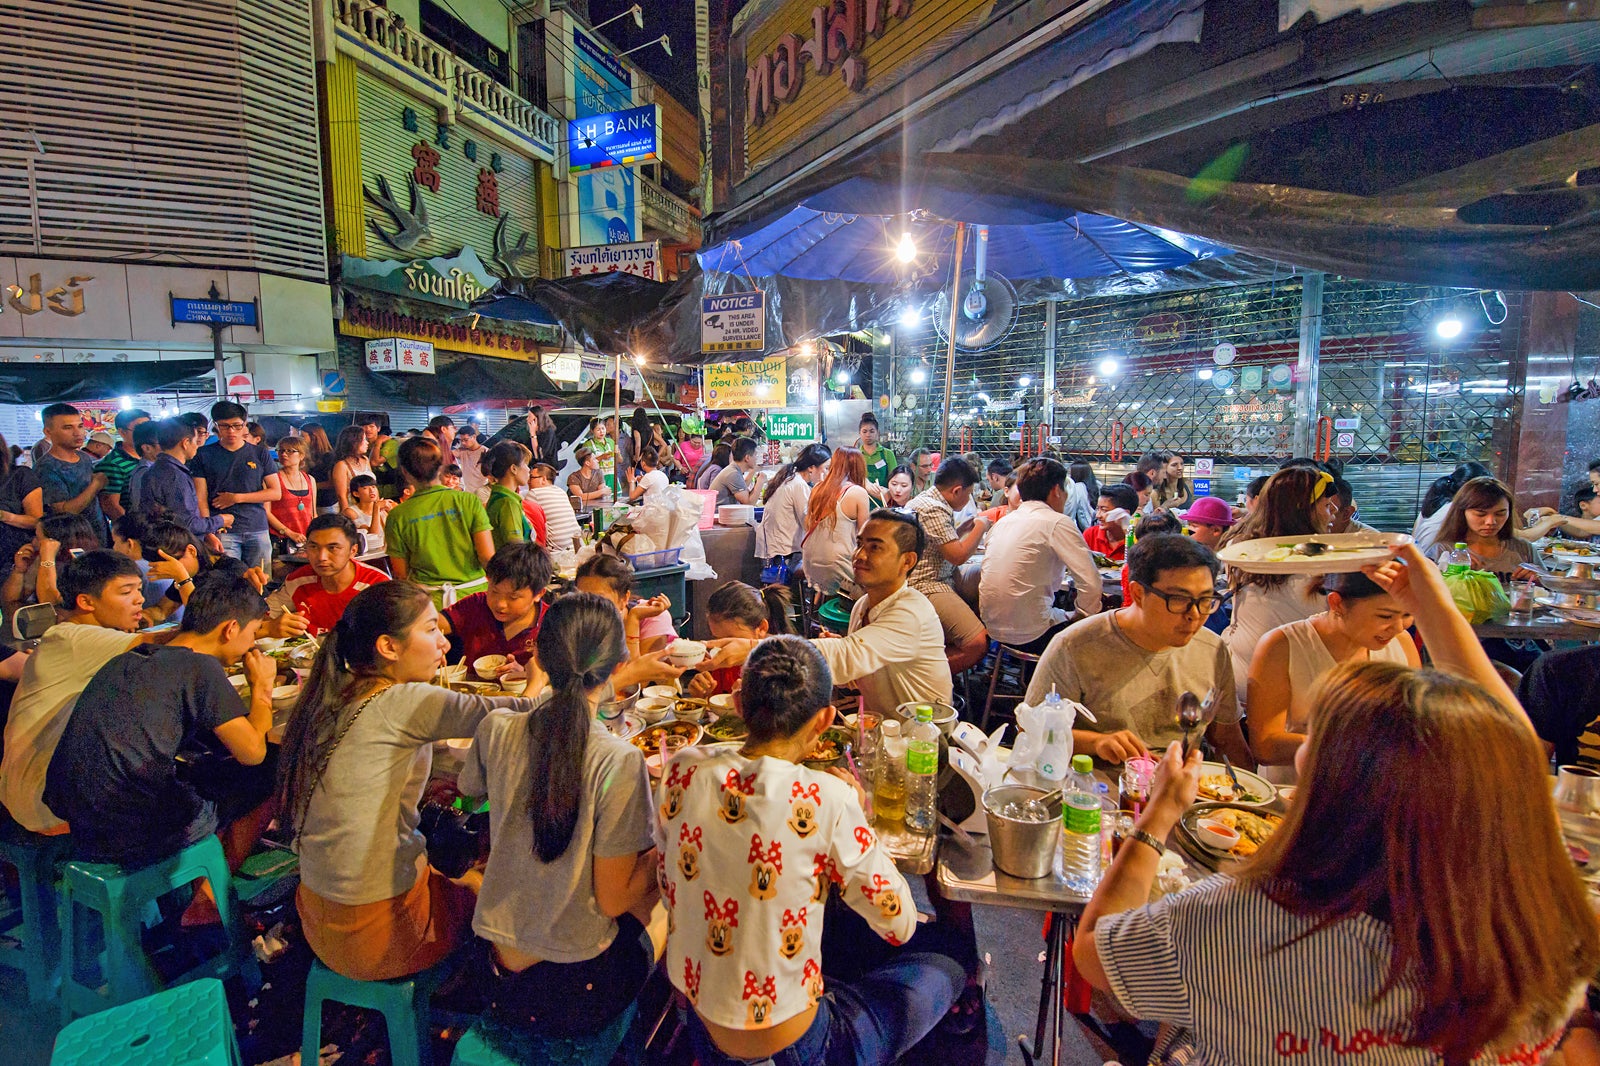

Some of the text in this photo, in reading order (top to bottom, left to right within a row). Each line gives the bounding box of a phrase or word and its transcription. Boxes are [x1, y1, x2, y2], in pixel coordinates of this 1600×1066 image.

[577, 112, 652, 141] LH BANK
[570, 244, 654, 266] รังนกใต้เยาวราช
[710, 296, 755, 311] NOTICE
[220, 315, 245, 323] TOWN
[722, 333, 761, 342] SURVEILLANCE
[736, 361, 782, 374] SEAFOOD
[768, 415, 813, 437] ไม่มีสาขา
